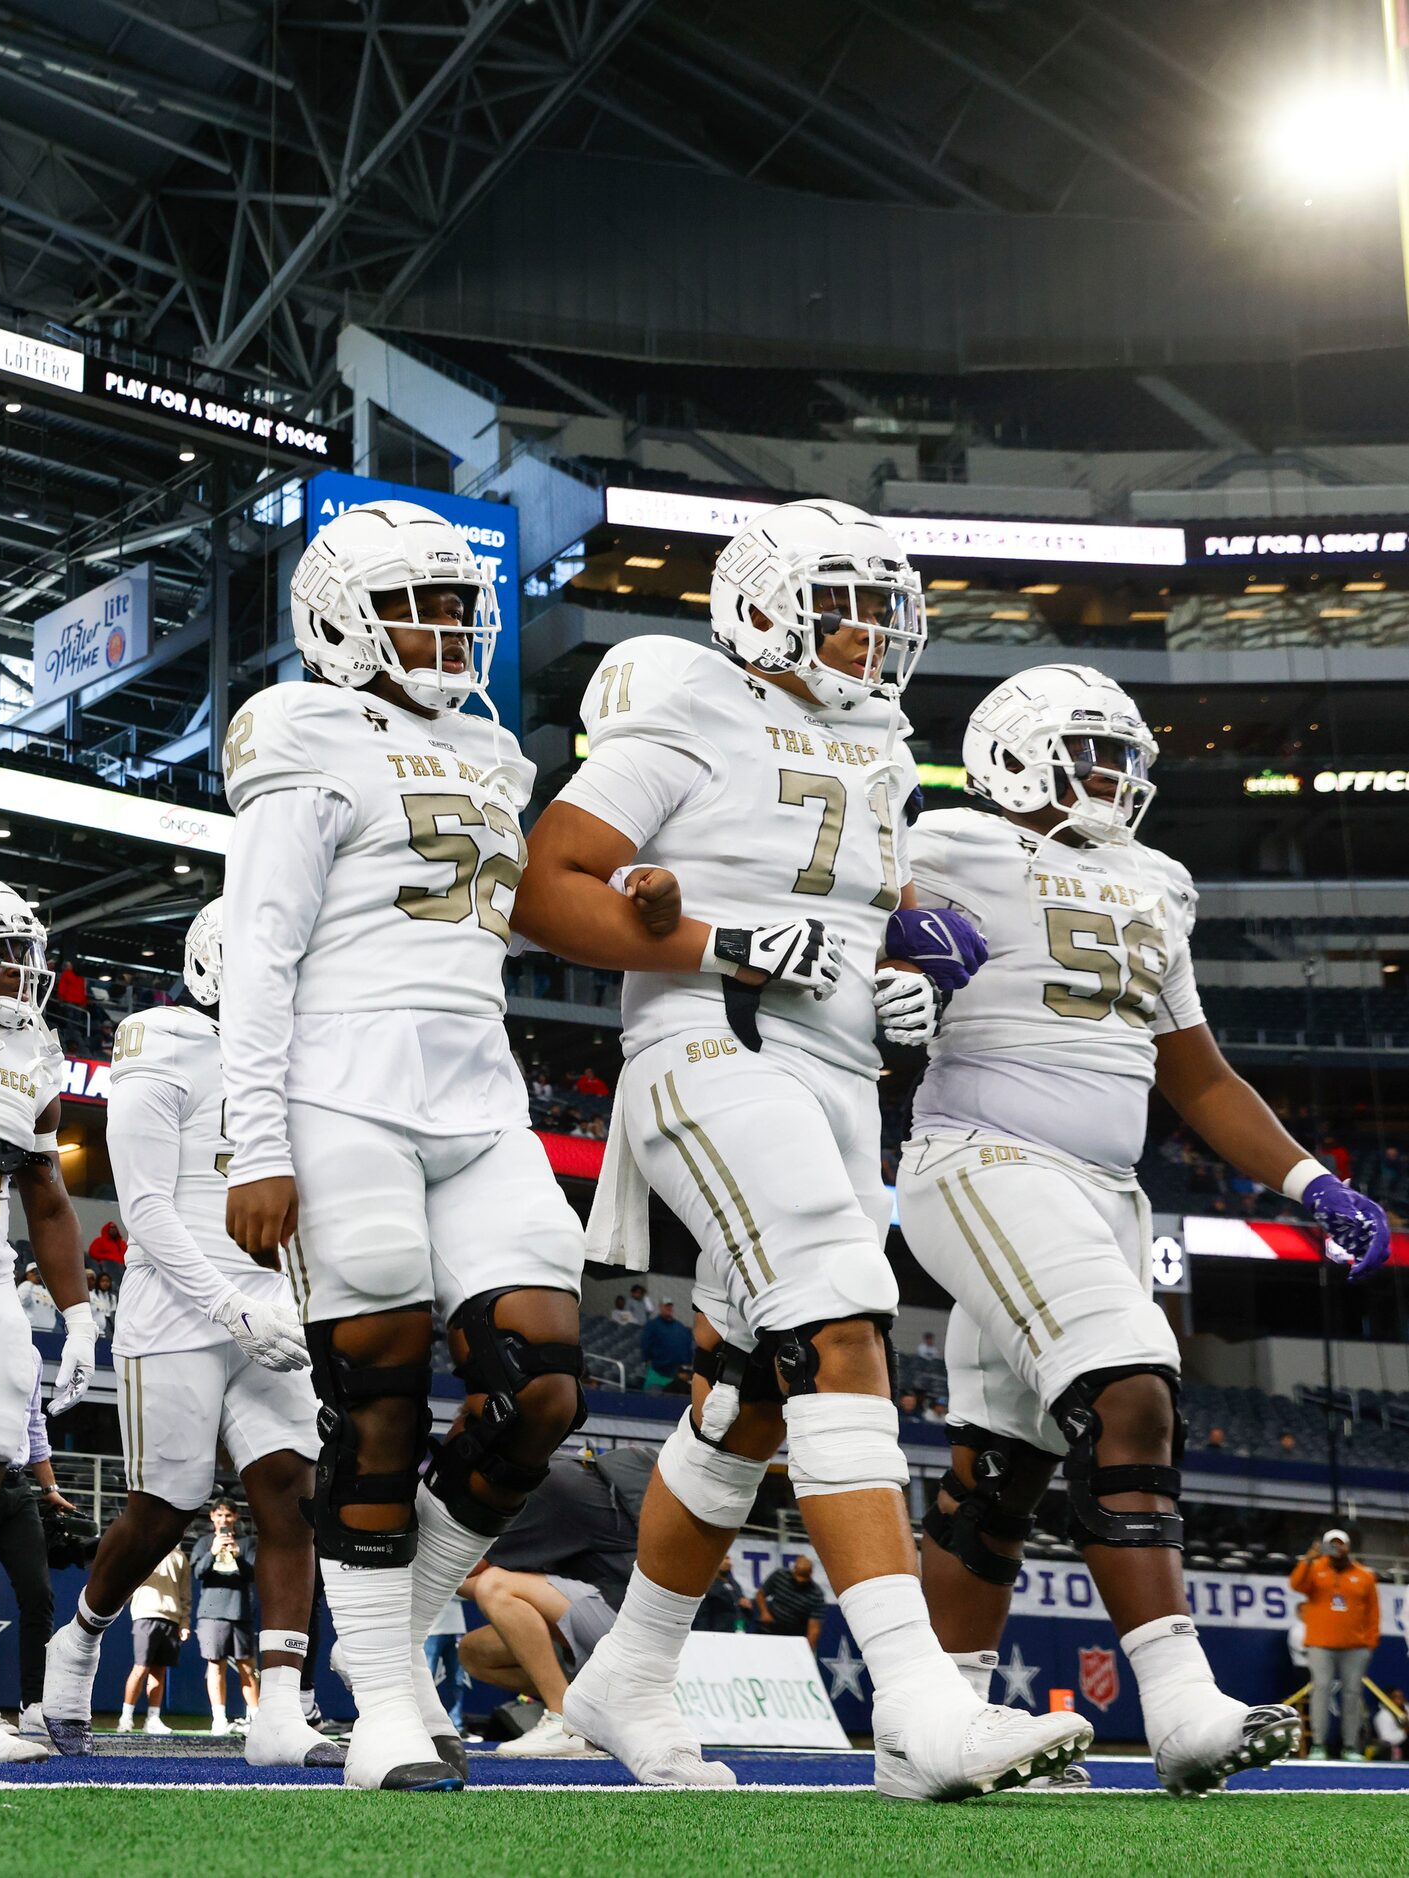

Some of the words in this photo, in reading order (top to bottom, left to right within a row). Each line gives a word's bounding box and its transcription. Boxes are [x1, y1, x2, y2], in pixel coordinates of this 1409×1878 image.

[5, 350, 70, 382] LOTTERY
[106, 372, 147, 400] PLAY
[151, 386, 186, 413] FOR
[191, 398, 202, 418] A
[205, 402, 250, 431] SHOT
[253, 417, 273, 438] AT
[320, 498, 335, 516] A
[1205, 536, 1256, 556] PLAY
[1257, 535, 1303, 554] FOR
[1304, 535, 1321, 553] A
[1321, 532, 1380, 553] SHOT
[716, 532, 784, 598] SOC
[104, 594, 129, 627] Lite
[61, 619, 84, 646] IT'S
[45, 622, 101, 684] Miller
[71, 647, 100, 676] TIME
[761, 648, 785, 668] SPORT
[599, 662, 634, 718] 71
[224, 711, 256, 781] 52
[765, 726, 815, 756] THE
[822, 740, 879, 767] MECC
[387, 755, 446, 778] THE
[1314, 771, 1409, 792] OFFIC
[159, 816, 210, 838] ONCOR
[778, 768, 902, 912] 71
[394, 794, 528, 942] 52
[1034, 873, 1085, 897] THE
[1043, 907, 1168, 1029] 58
[114, 1022, 145, 1061] 90
[686, 1037, 737, 1063] SOC
[979, 1145, 1027, 1166] SOC
[355, 1545, 385, 1553] THUASNE
